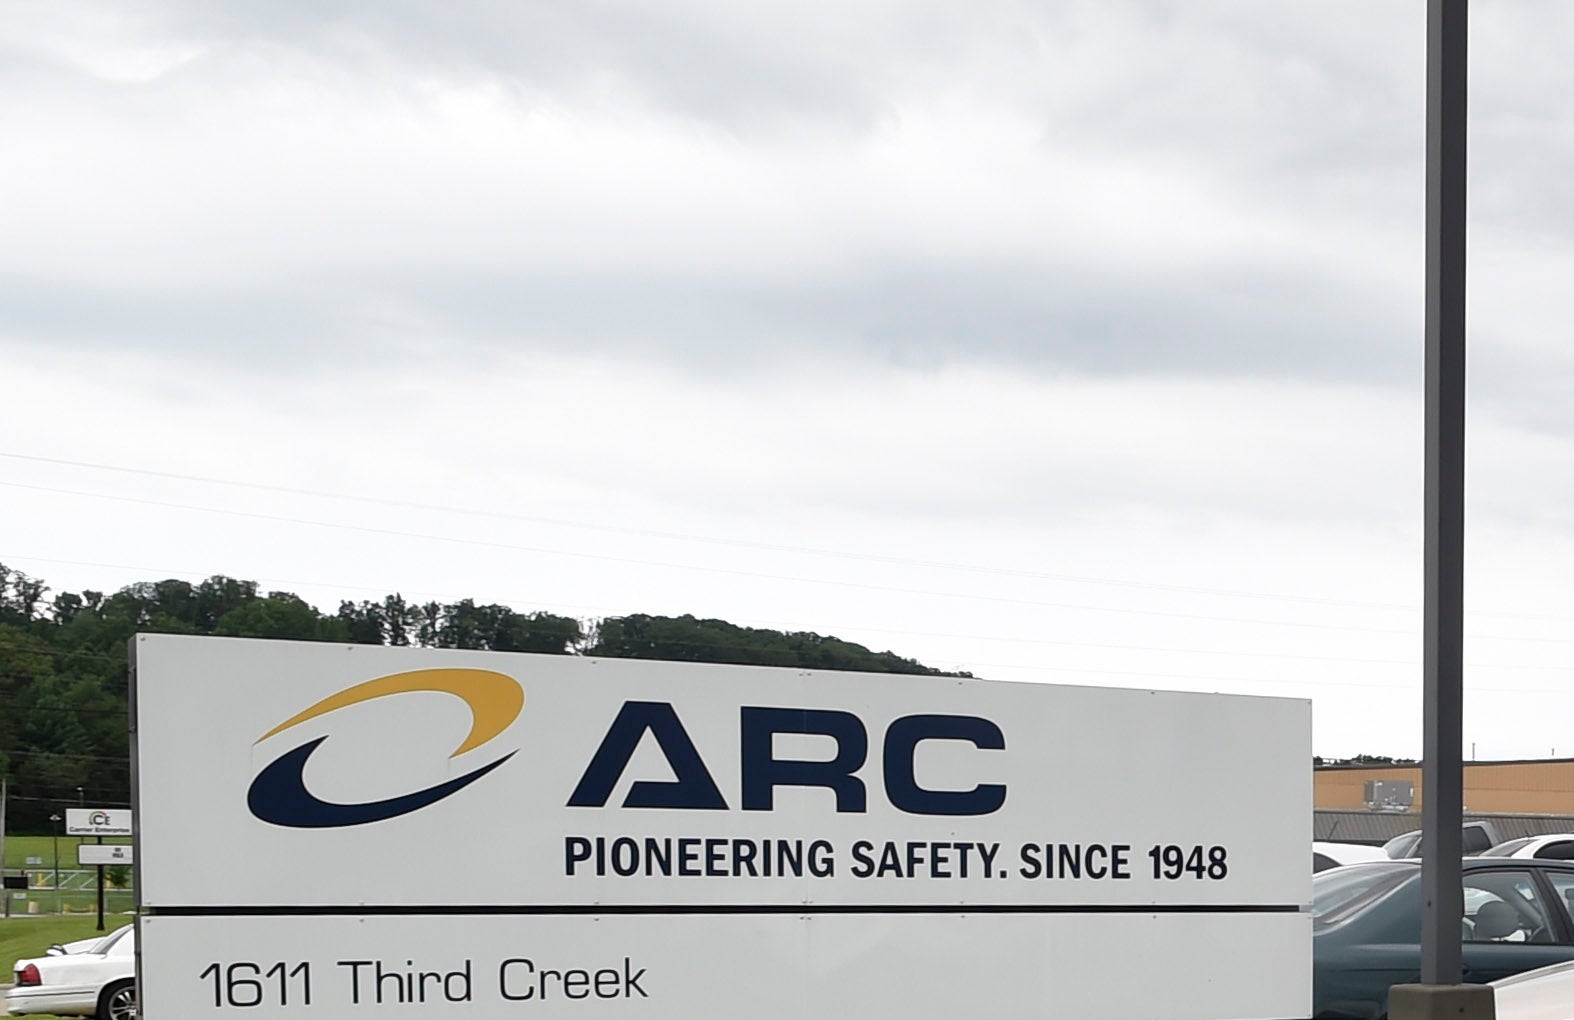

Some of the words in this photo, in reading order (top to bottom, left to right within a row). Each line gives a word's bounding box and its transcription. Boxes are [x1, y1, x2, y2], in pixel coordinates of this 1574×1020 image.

[565, 700, 1008, 818] ARC
[565, 835, 836, 878] PIONEERING
[850, 840, 1007, 879] SAFETY.
[1019, 842, 1132, 880] SINCE
[1147, 844, 1229, 881] 1948
[199, 961, 312, 1008] 1611
[336, 959, 473, 1004] Third
[499, 957, 649, 1001] Creek
